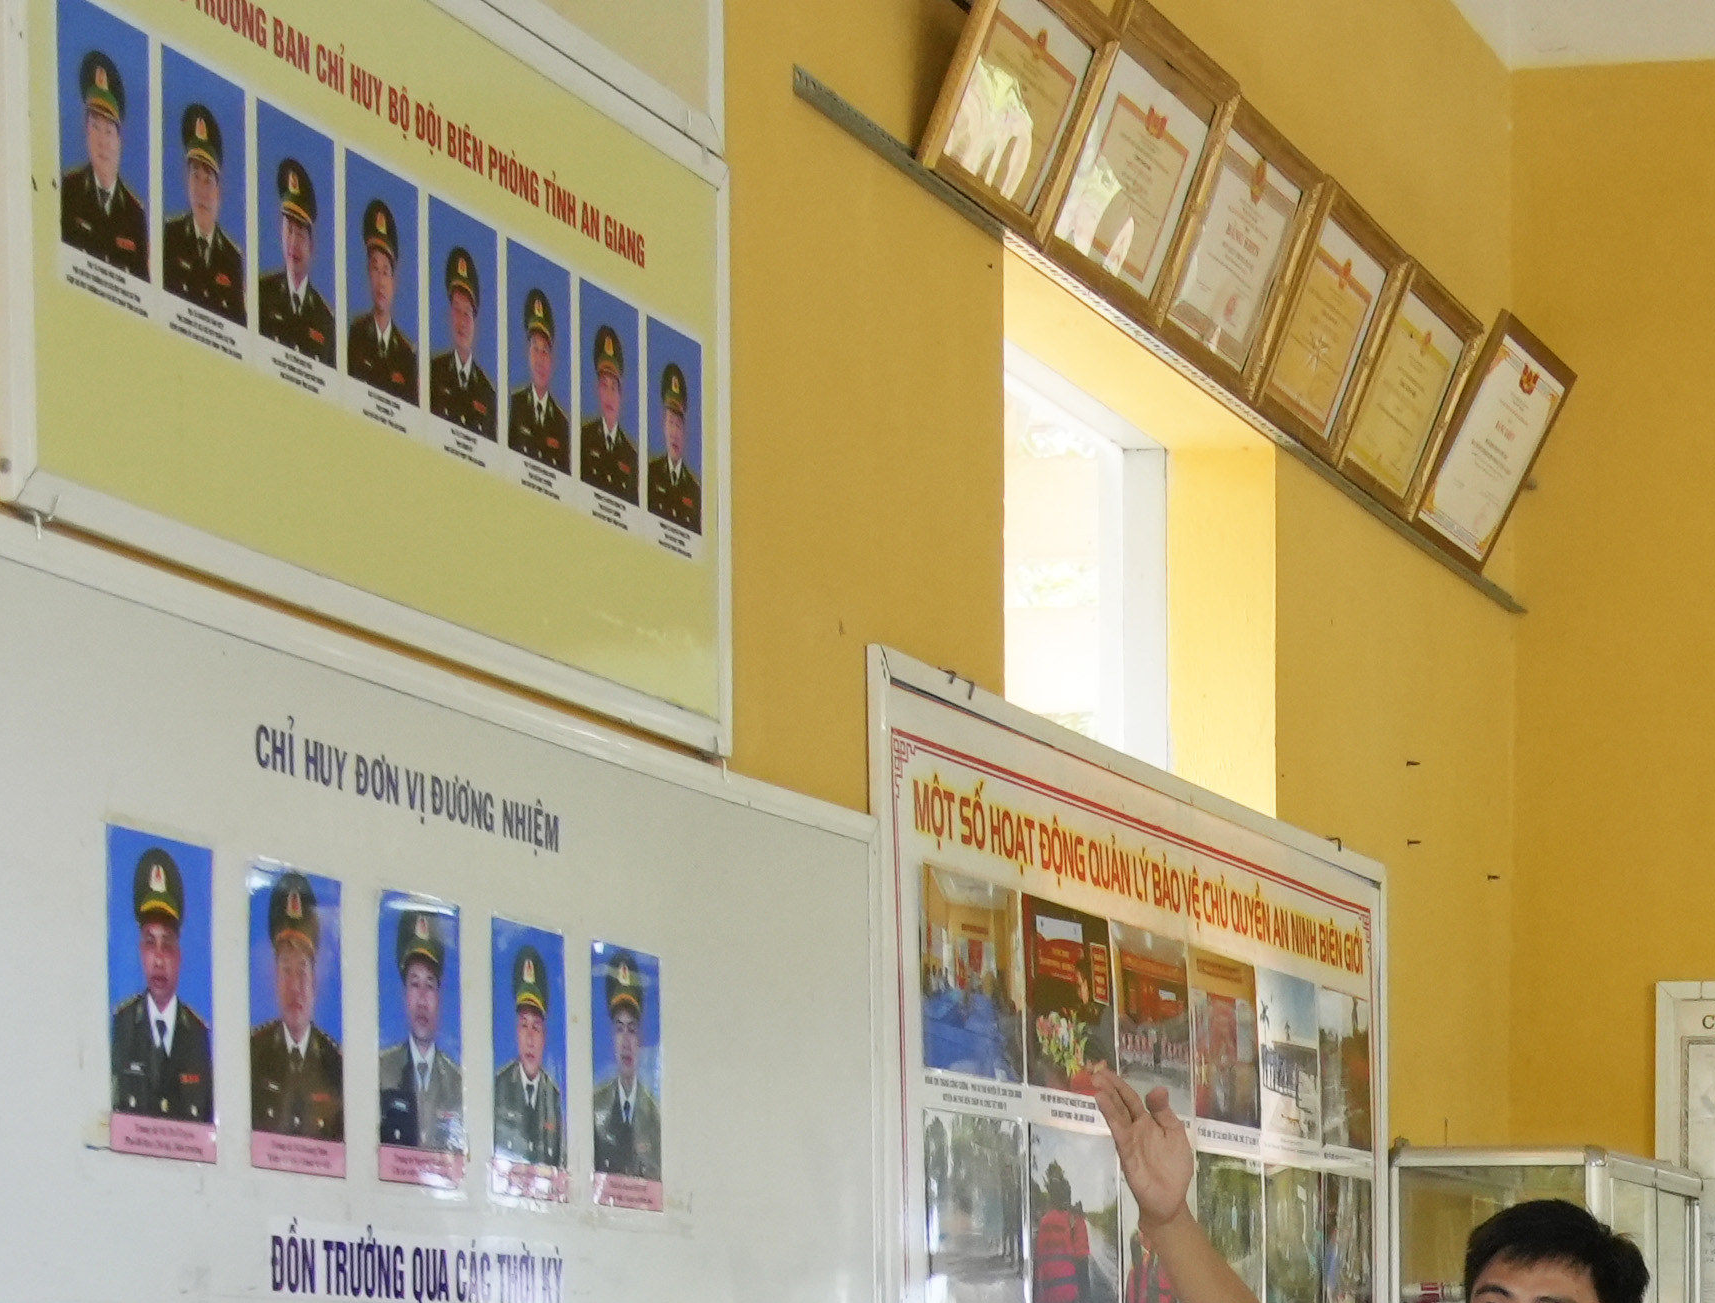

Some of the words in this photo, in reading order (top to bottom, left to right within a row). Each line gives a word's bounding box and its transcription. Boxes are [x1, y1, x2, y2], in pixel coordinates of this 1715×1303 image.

[273, 16, 310, 75] BAN
[316, 43, 345, 95] CHỈ
[350, 63, 383, 117] HUY
[388, 85, 410, 140] BỘ
[415, 101, 442, 156] ĐỘI
[447, 120, 483, 176] BIÊN
[488, 144, 539, 208] PHÒNG
[543, 170, 577, 230] TỈNH
[580, 200, 600, 244] AN
[604, 214, 646, 269] GIANG
[255, 715, 295, 777] CHỈ
[304, 738, 348, 791] HUY
[354, 753, 400, 806] ĐƠN
[405, 767, 425, 825] VỊ
[431, 774, 495, 834] ĐƯƠNG
[502, 798, 560, 857] NHIỆM
[912, 773, 955, 850] MỘT
[959, 780, 986, 851] SỐ
[989, 804, 1035, 876] HOẠT
[1039, 815, 1087, 887] ĐỘNG
[1088, 833, 1132, 897] QUẢN
[1132, 847, 1149, 902] LÝ
[1152, 852, 1181, 914] BẢO
[1181, 865, 1202, 931] VỆ
[1202, 874, 1228, 929] CHỦ
[1230, 881, 1272, 945] QUYỀN
[1273, 906, 1290, 951] AN
[1290, 912, 1318, 961] NINH
[1318, 917, 1343, 969] BIÊN
[1344, 926, 1364, 976] GIỚI
[271, 1217, 316, 1294] ĐỒN
[323, 1224, 405, 1300] TRƯỞNG
[455, 1239, 492, 1303] CÁC
